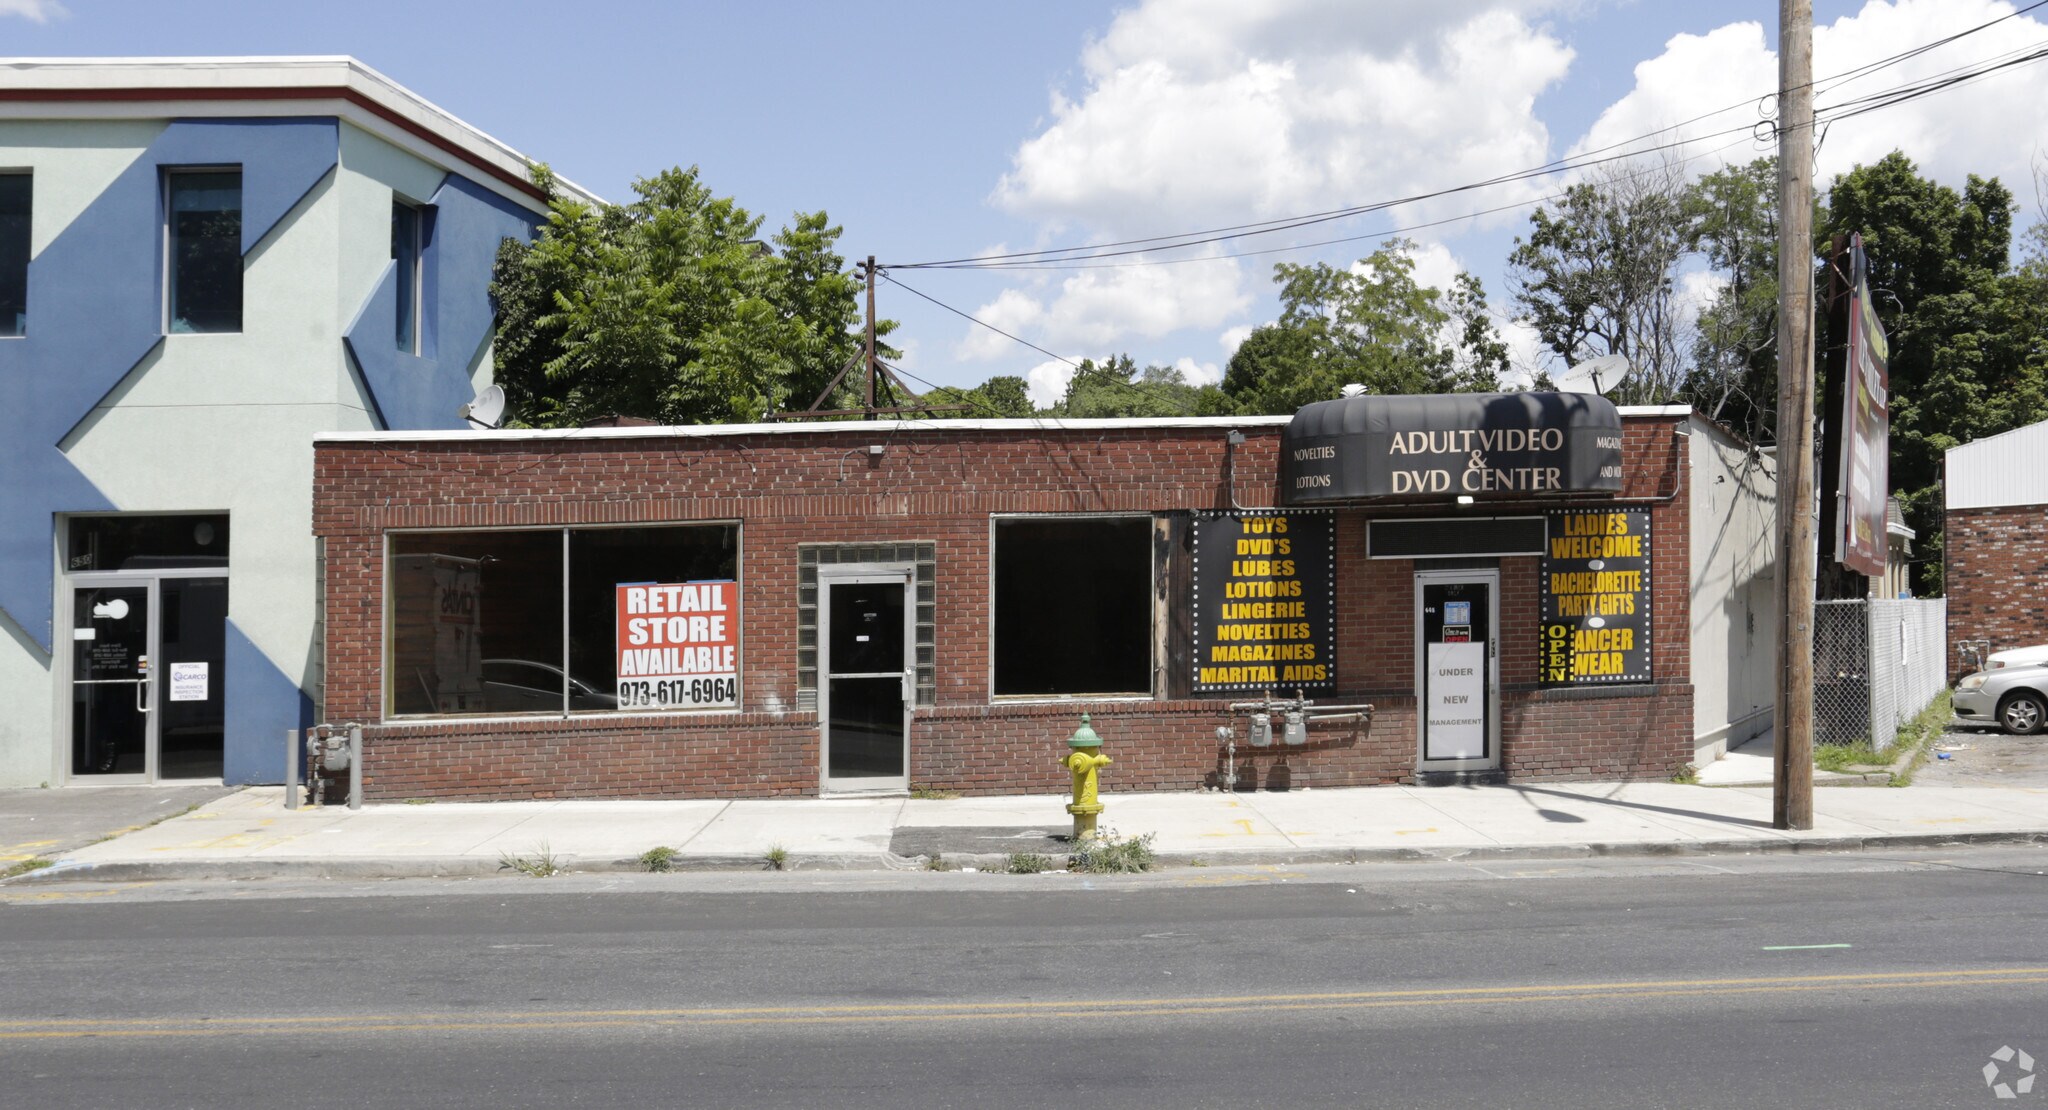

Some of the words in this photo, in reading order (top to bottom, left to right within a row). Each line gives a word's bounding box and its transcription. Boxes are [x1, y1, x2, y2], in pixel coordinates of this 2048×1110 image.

[1389, 430, 1475, 455] ADULT
[1478, 428, 1564, 452] VIDEO
[1294, 446, 1336, 461] NOVELTIES
[1468, 449, 1488, 469] &
[1296, 474, 1331, 489] LOTIONS
[1391, 469, 1451, 494] DVD
[1461, 467, 1562, 492] CENTER
[1599, 465, 1613, 478] AND
[1241, 517, 1288, 534] TOYS
[1564, 513, 1629, 536] LADIES
[1236, 538, 1291, 556] DVD'S
[1551, 536, 1642, 559] WELCOME
[1232, 559, 1295, 577] LUBES
[1225, 580, 1302, 599] LOTIONS
[1551, 570, 1641, 594] BACHELORETTE
[627, 585, 727, 614] RETAIL
[1558, 594, 1597, 617] PARTY
[1599, 592, 1635, 615] GIFTS
[1222, 601, 1305, 620] LINGERIE
[628, 615, 726, 645] STORE
[1217, 622, 1310, 641] NOVELTIES
[1575, 628, 1633, 652] ANCER
[620, 645, 735, 676] AVAILABLE
[1211, 644, 1315, 663] MAGAZINES
[1548, 625, 1566, 682] OPEN
[1200, 667, 1278, 684] MARITAL
[1282, 664, 1326, 682] AIDS
[1439, 668, 1473, 677] UNDER
[620, 677, 735, 706] 973-617-6964
[1443, 695, 1469, 704] NEW
[1429, 718, 1482, 726] MANAGEMENT
